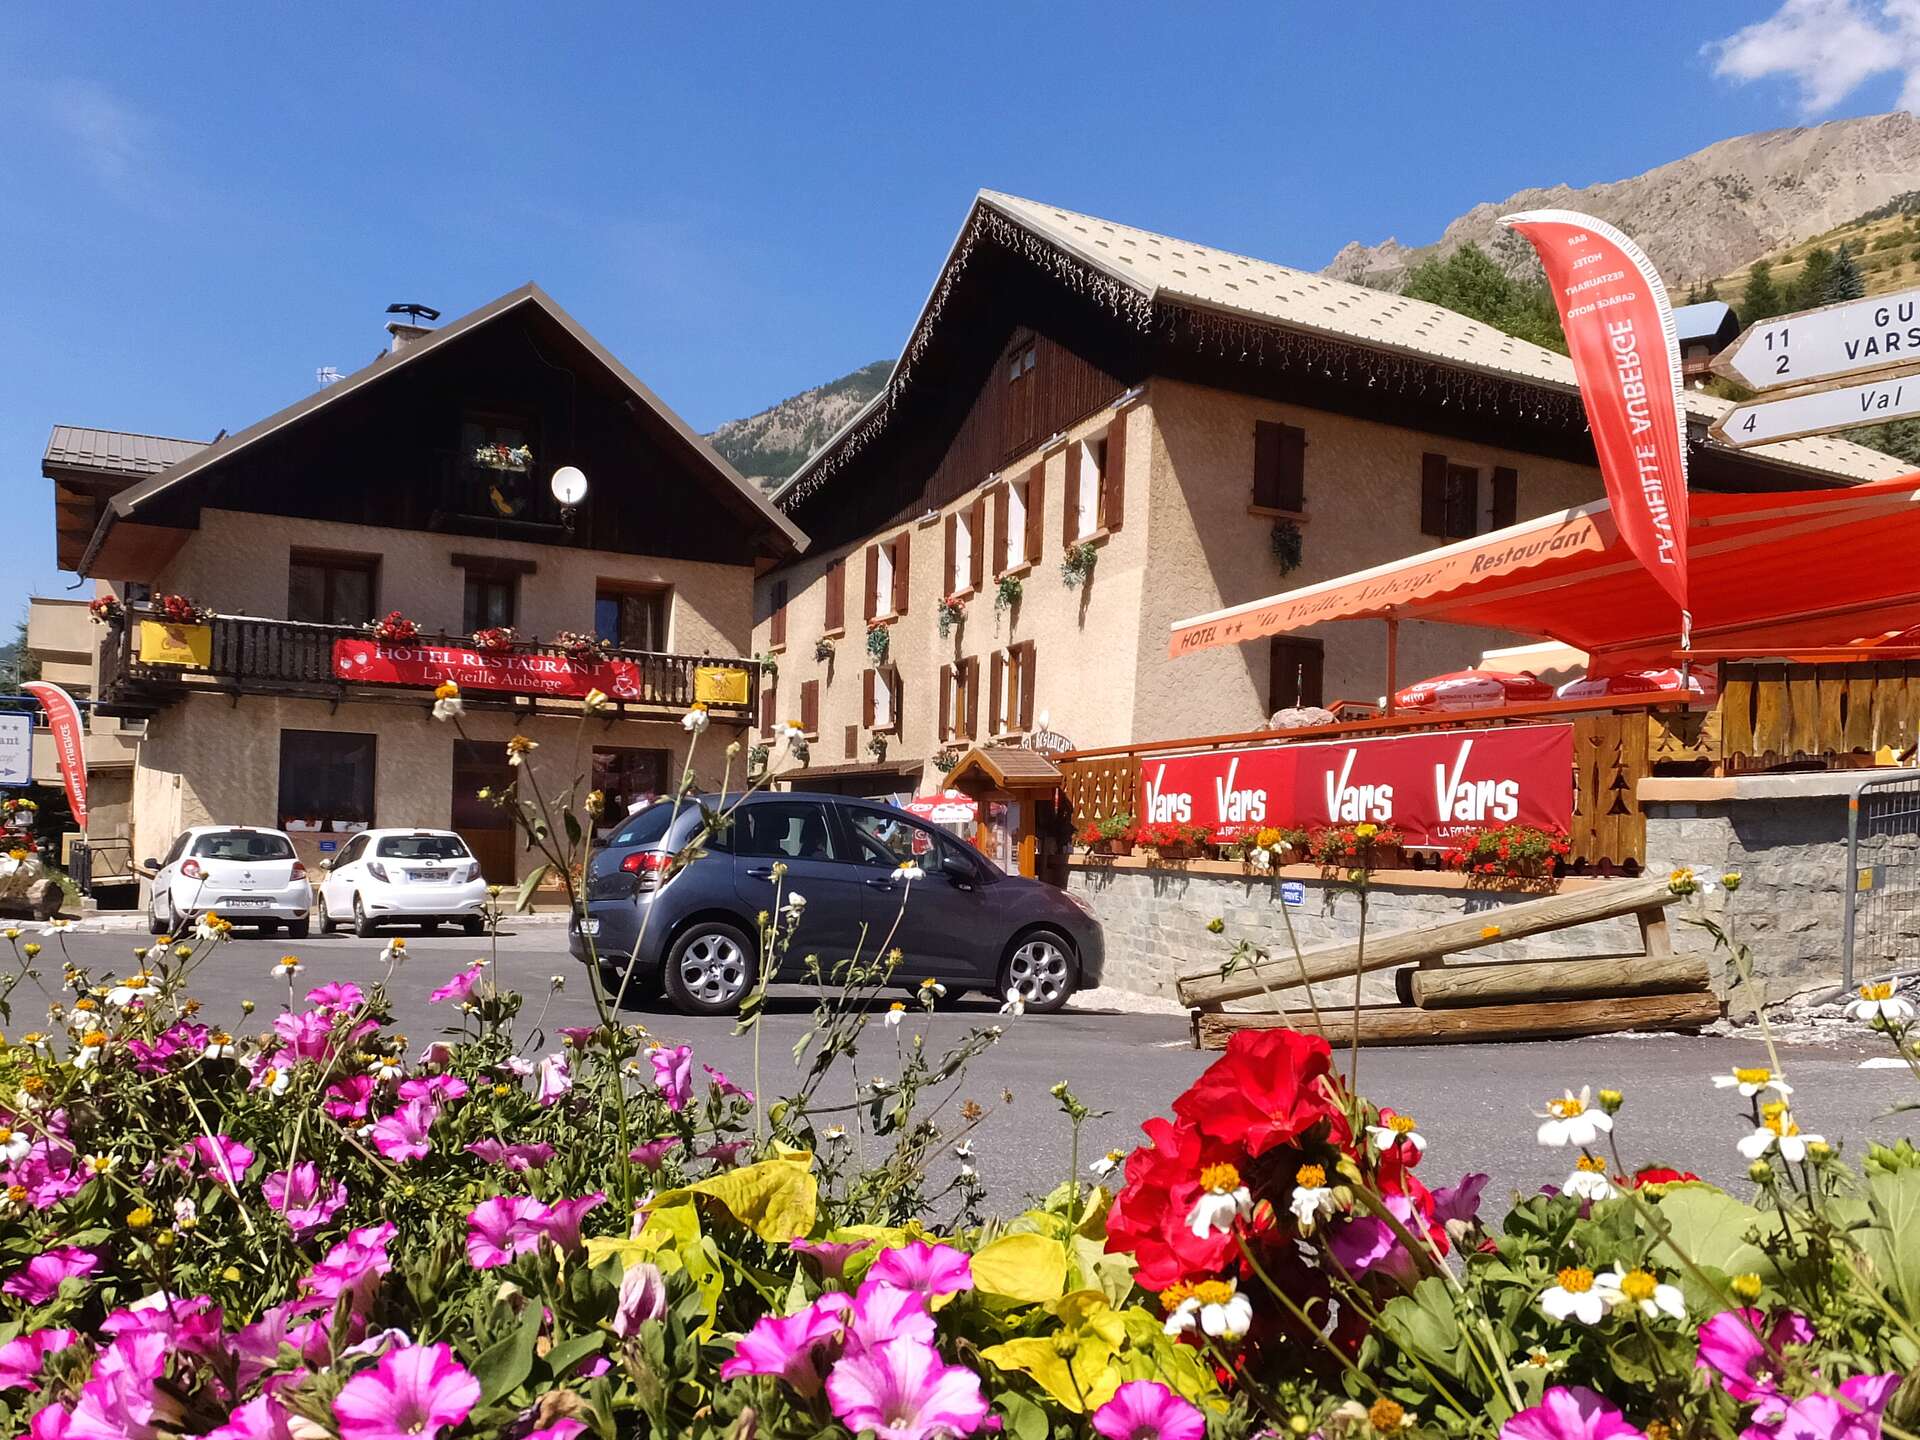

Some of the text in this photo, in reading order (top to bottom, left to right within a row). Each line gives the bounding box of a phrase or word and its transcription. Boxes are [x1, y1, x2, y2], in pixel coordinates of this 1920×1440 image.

[1764, 302, 1914, 351] 11 GU
[1775, 327, 1920, 375] 2 VARS
[1743, 386, 1902, 433] 4 Val
[1181, 627, 1216, 648] HOTEL
[1470, 524, 1592, 574] Restaurant
[423, 666, 562, 693] La Vieille Auberge
[462, 653, 604, 676] RESTAURANT
[1146, 739, 1519, 823] Vars Vars Vars Vars
